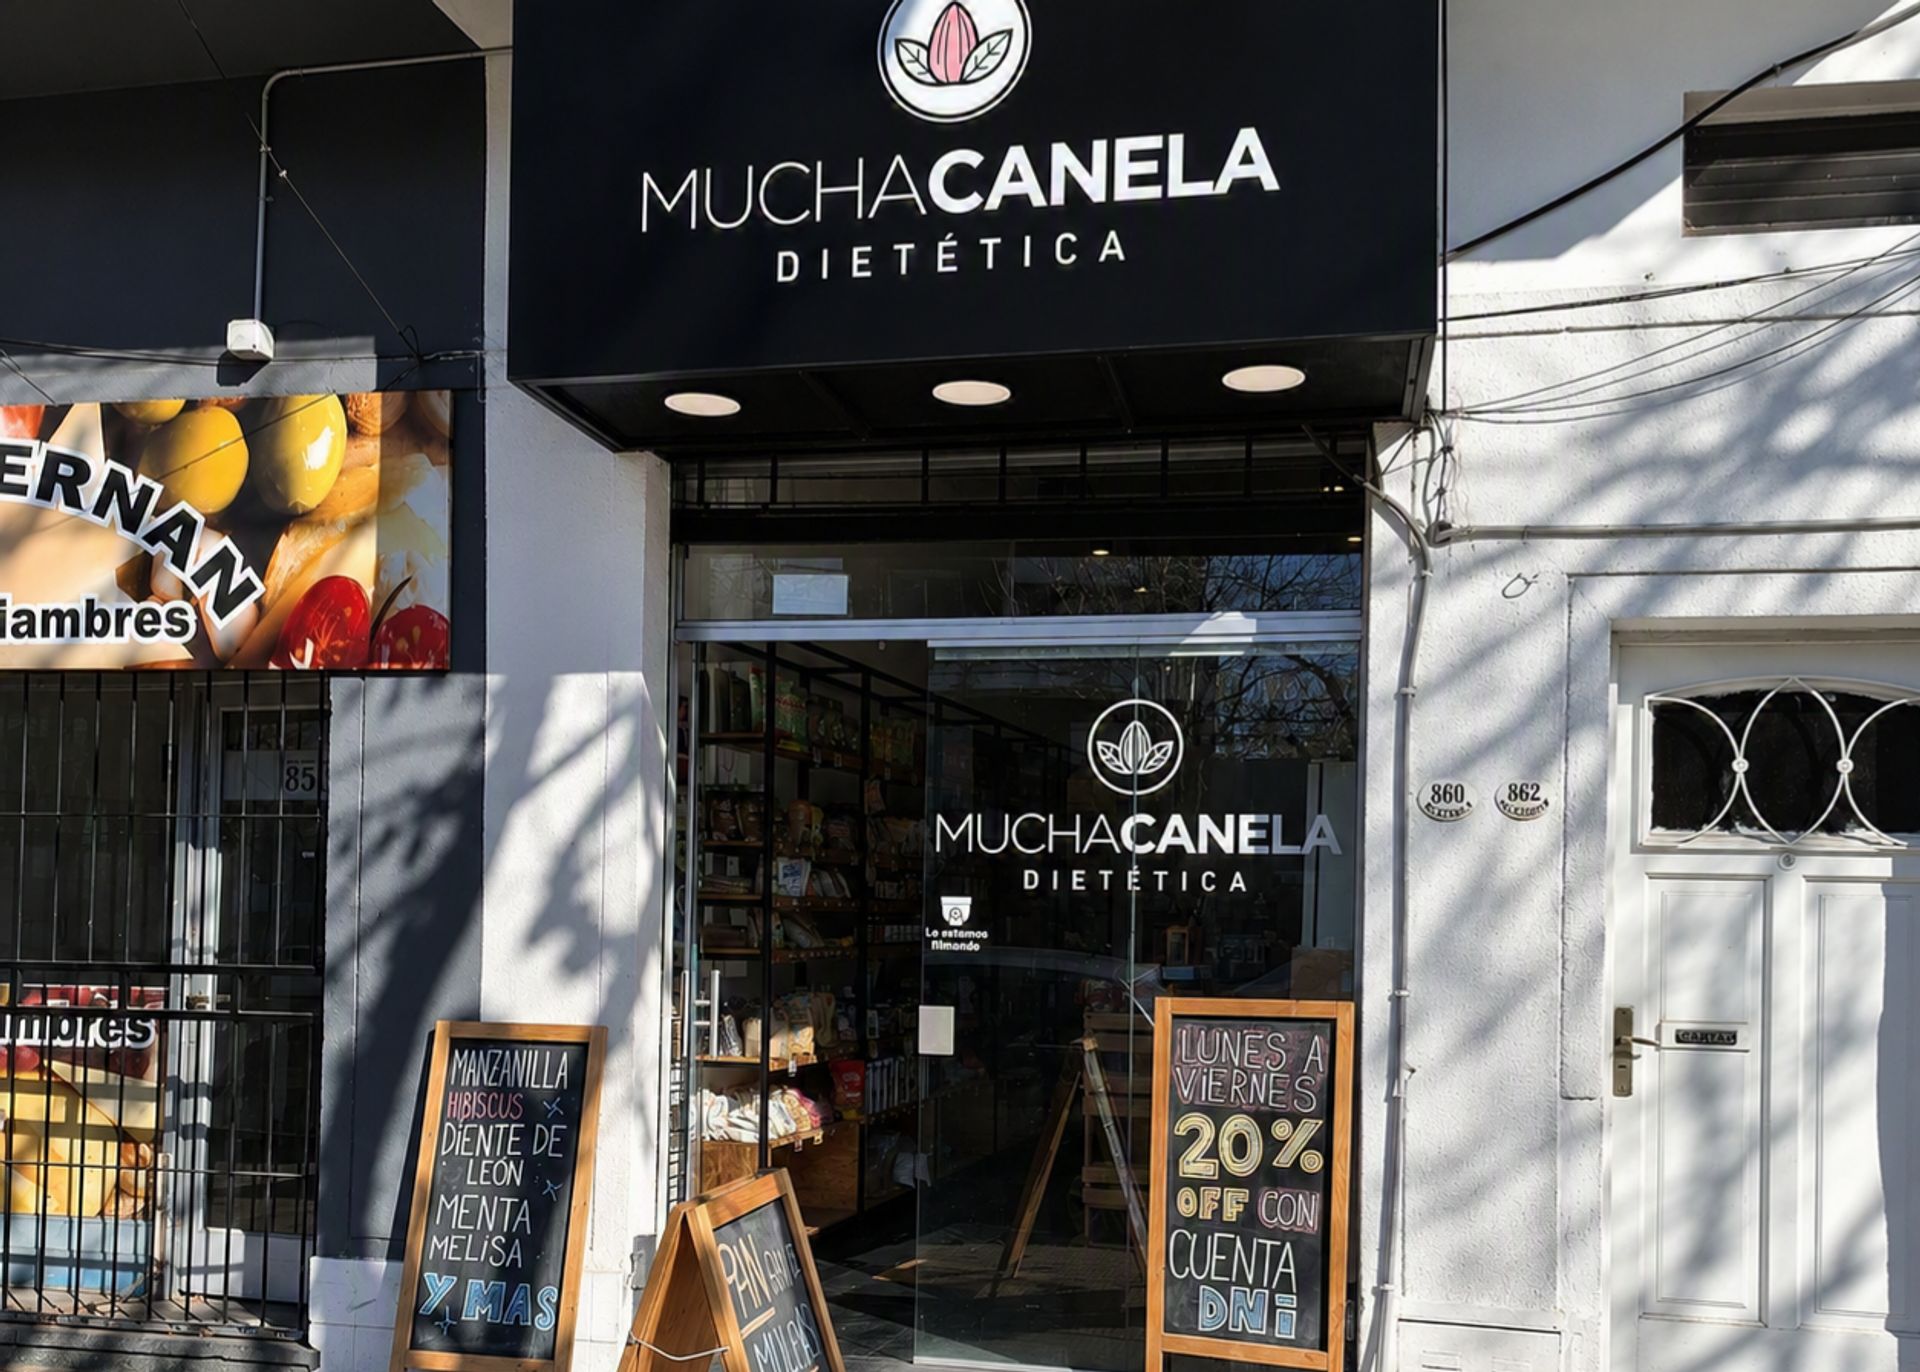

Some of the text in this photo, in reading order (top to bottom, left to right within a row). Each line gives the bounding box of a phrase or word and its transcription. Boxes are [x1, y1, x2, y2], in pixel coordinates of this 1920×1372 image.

[776, 230, 1126, 283] DIETÉTICA
[284, 765, 329, 792] 85
[1430, 783, 1465, 805] 860
[1507, 782, 1541, 803] 862
[1023, 865, 1247, 892] DIETÉTICA
[451, 1049, 569, 1090] MANZANILLA
[1179, 1028, 1325, 1075] LUNES A
[447, 1091, 524, 1121] HIBISCUS
[532, 1124, 568, 1158] DE
[466, 1156, 525, 1187] LEÓN
[435, 1194, 531, 1235] MENTA
[1176, 1186, 1319, 1231] OFF CON
[1168, 1228, 1297, 1294] CUENTA
[419, 1272, 559, 1333] Y MAS
